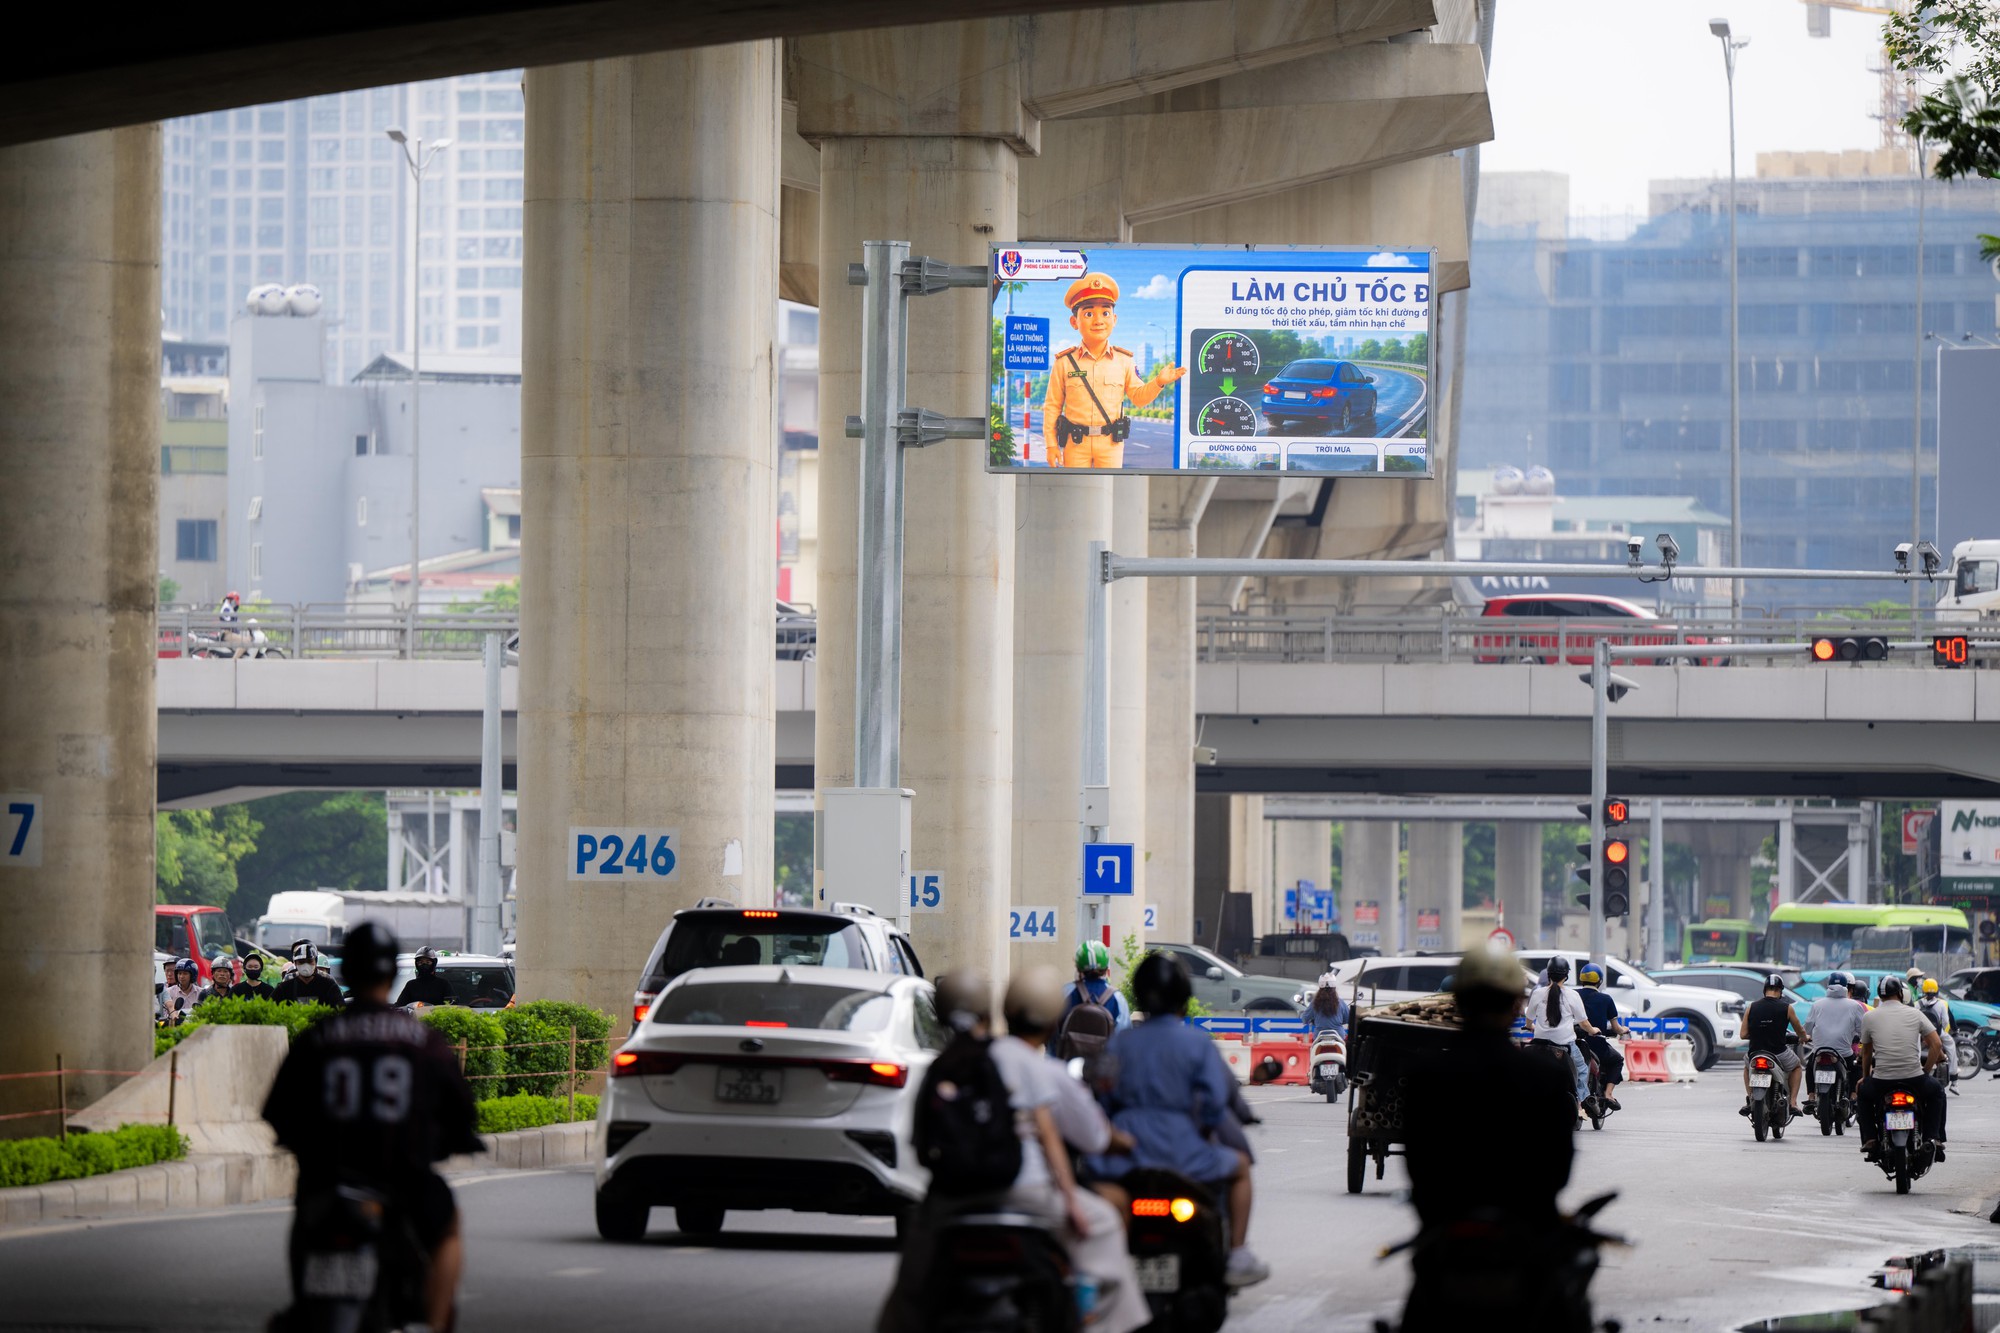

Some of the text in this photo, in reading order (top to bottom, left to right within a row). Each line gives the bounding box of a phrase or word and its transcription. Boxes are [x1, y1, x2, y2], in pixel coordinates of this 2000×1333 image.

[1232, 277, 1285, 301] LÀM
[1293, 276, 1347, 302] CHỦ
[1355, 276, 1406, 303] TỐC
[1225, 306, 1234, 315] Đi
[1236, 307, 1258, 317] đúng
[1261, 306, 1275, 315] tốc
[1277, 307, 1288, 317] độ
[1290, 307, 1307, 316] cho
[1308, 307, 1333, 318] phép,
[1335, 307, 1357, 318] giảm
[1360, 306, 1373, 316] tốc
[1375, 307, 1389, 316] khi
[1391, 308, 1420, 319] đường
[1013, 322, 1038, 331] AN TOÀN
[1272, 318, 1289, 327] thời
[1291, 318, 1307, 327] tiết
[1309, 318, 1328, 328] xấu,
[1371, 319, 1387, 329] hạn
[1389, 319, 1406, 328] chế
[1010, 333, 1044, 342] GIAO THÔNG
[1007, 343, 1047, 354] LÀ HẠNH PHÚC
[1009, 354, 1045, 364] CỦA MỌI NHÀ
[1209, 444, 1257, 452] ĐƯỜNG ĐÔNG
[1316, 444, 1333, 453] TRỜI
[1936, 637, 1966, 663] 40
[1608, 803, 1625, 821] 40
[9, 803, 34, 856] 7
[576, 834, 676, 876] P246
[324, 1055, 412, 1122] 09
